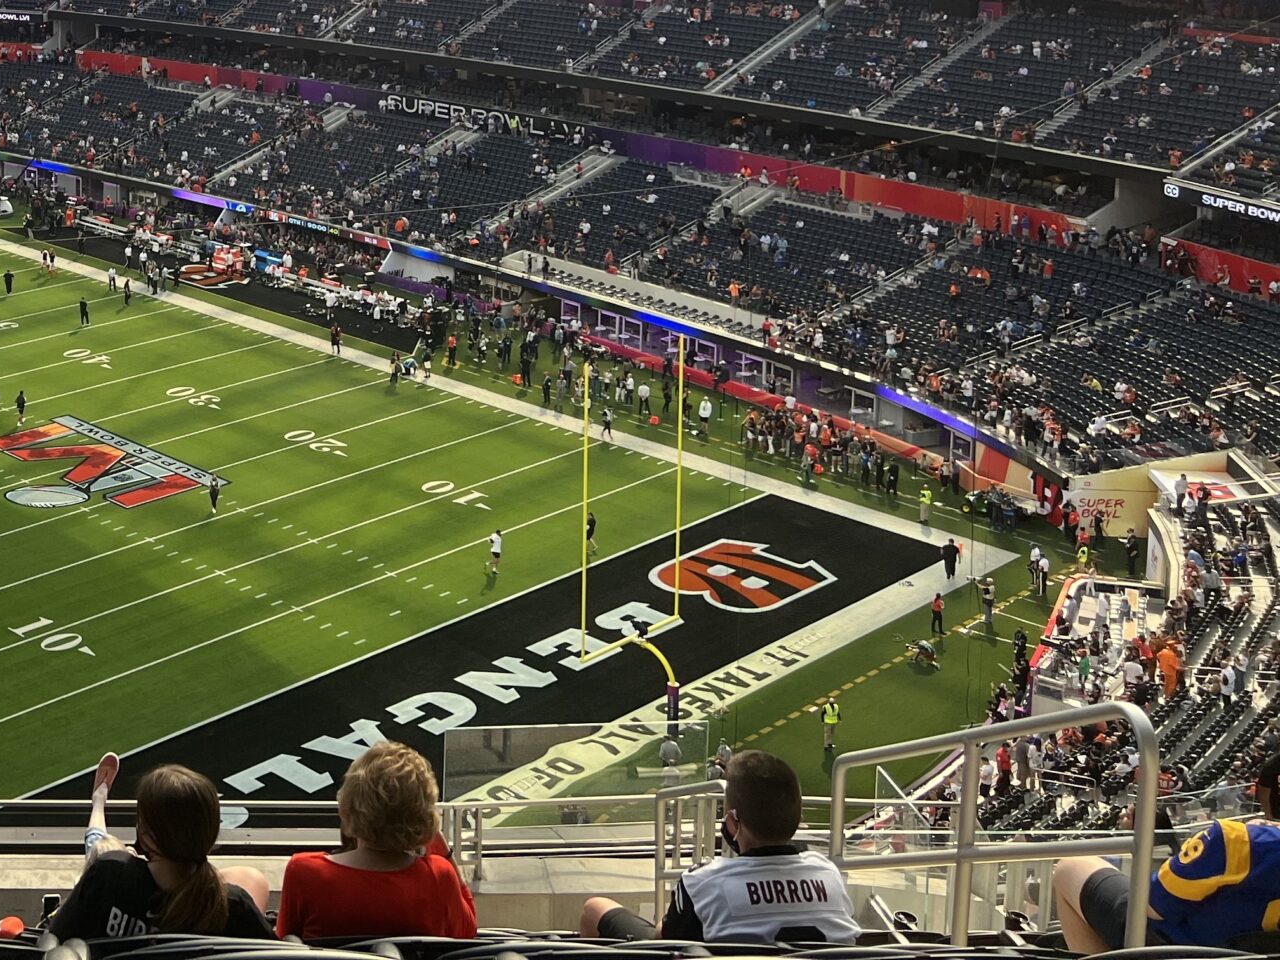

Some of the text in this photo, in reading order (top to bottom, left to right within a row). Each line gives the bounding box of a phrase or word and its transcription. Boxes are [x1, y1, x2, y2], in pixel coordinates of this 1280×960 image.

[1201, 194, 1245, 213] SUPER
[63, 348, 112, 365] 40
[166, 386, 218, 406] 30
[74, 421, 206, 480] SUPER BOWL
[284, 430, 348, 452] 20
[421, 480, 488, 506] 10
[1078, 498, 1125, 508] SUPER
[1089, 518, 1110, 528] LI
[8, 616, 83, 651] 10
[656, 666, 772, 719] TAKES
[220, 601, 685, 828] BENGAL
[529, 757, 585, 789] OF
[746, 879, 828, 905] BURROW
